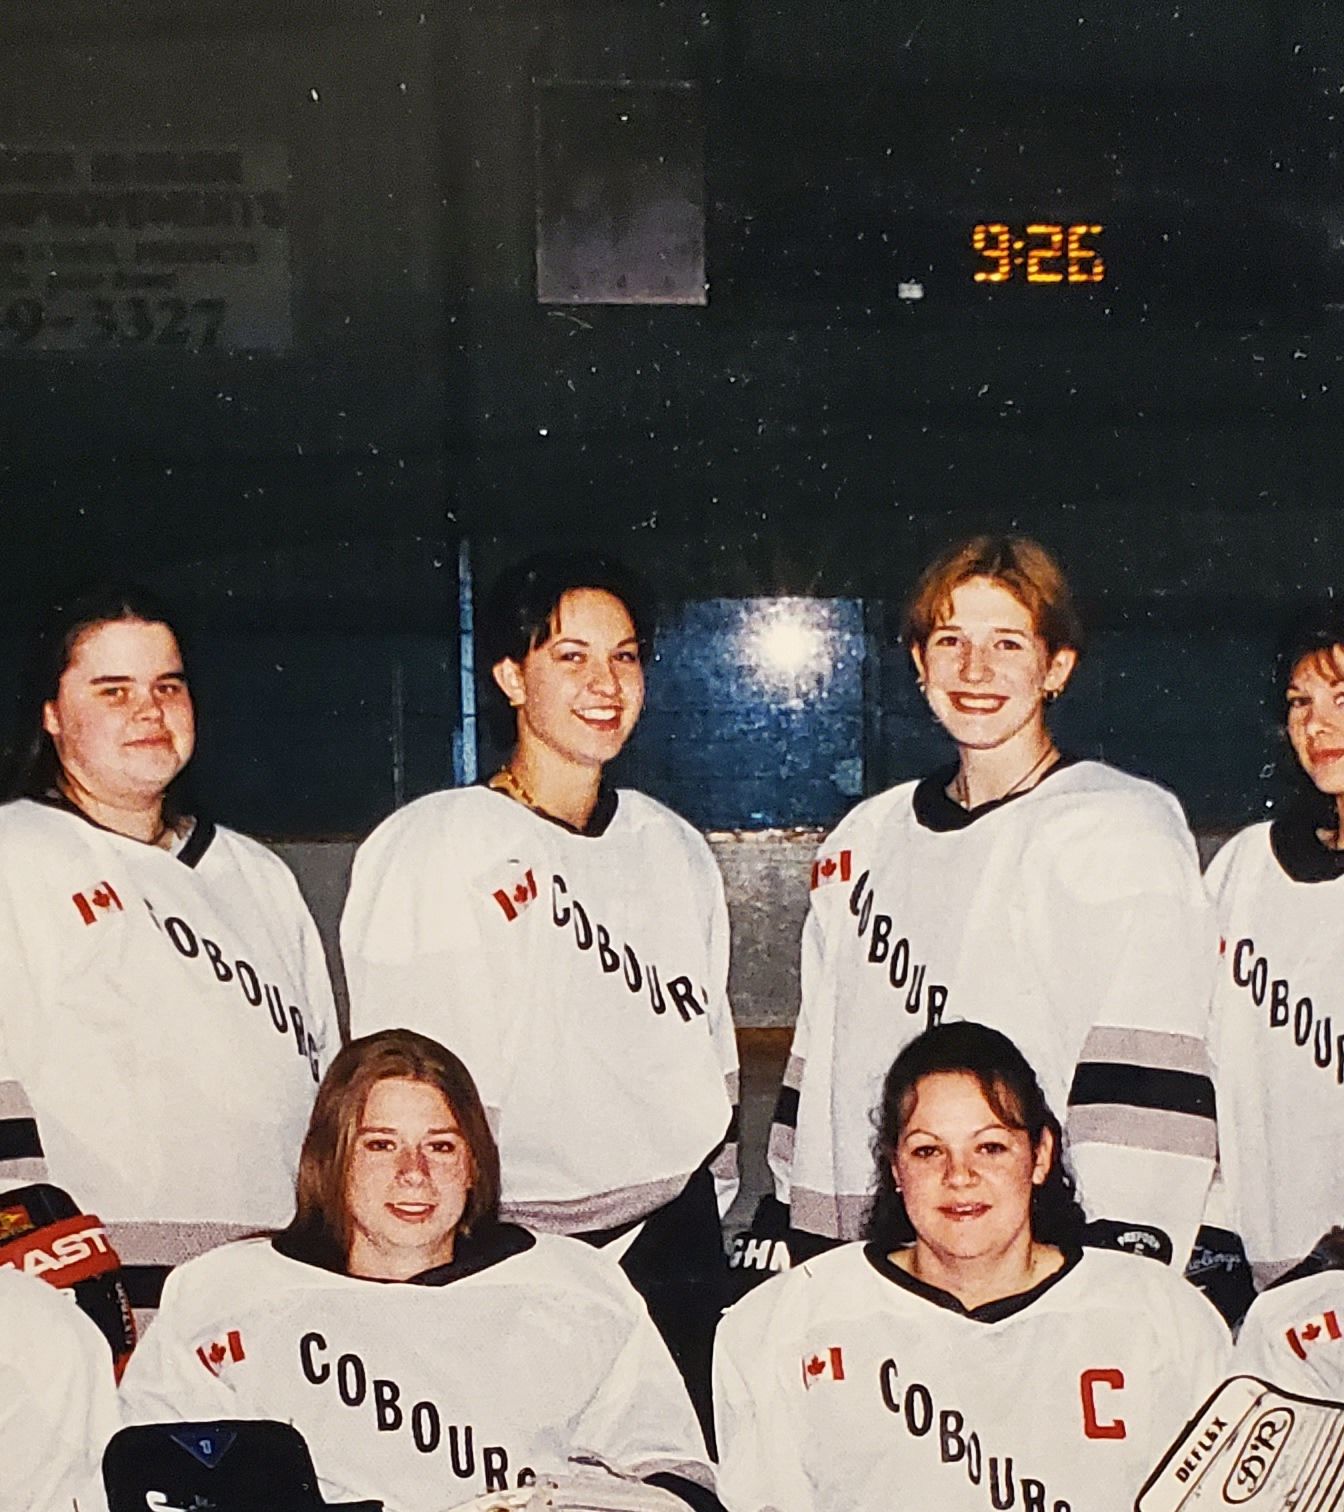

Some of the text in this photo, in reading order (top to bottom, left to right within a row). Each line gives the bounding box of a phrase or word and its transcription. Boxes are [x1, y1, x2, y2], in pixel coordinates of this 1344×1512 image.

[973, 224, 1104, 283] 9:26
[552, 874, 713, 1036] COBOUR
[1080, 1368, 1126, 1439] C
